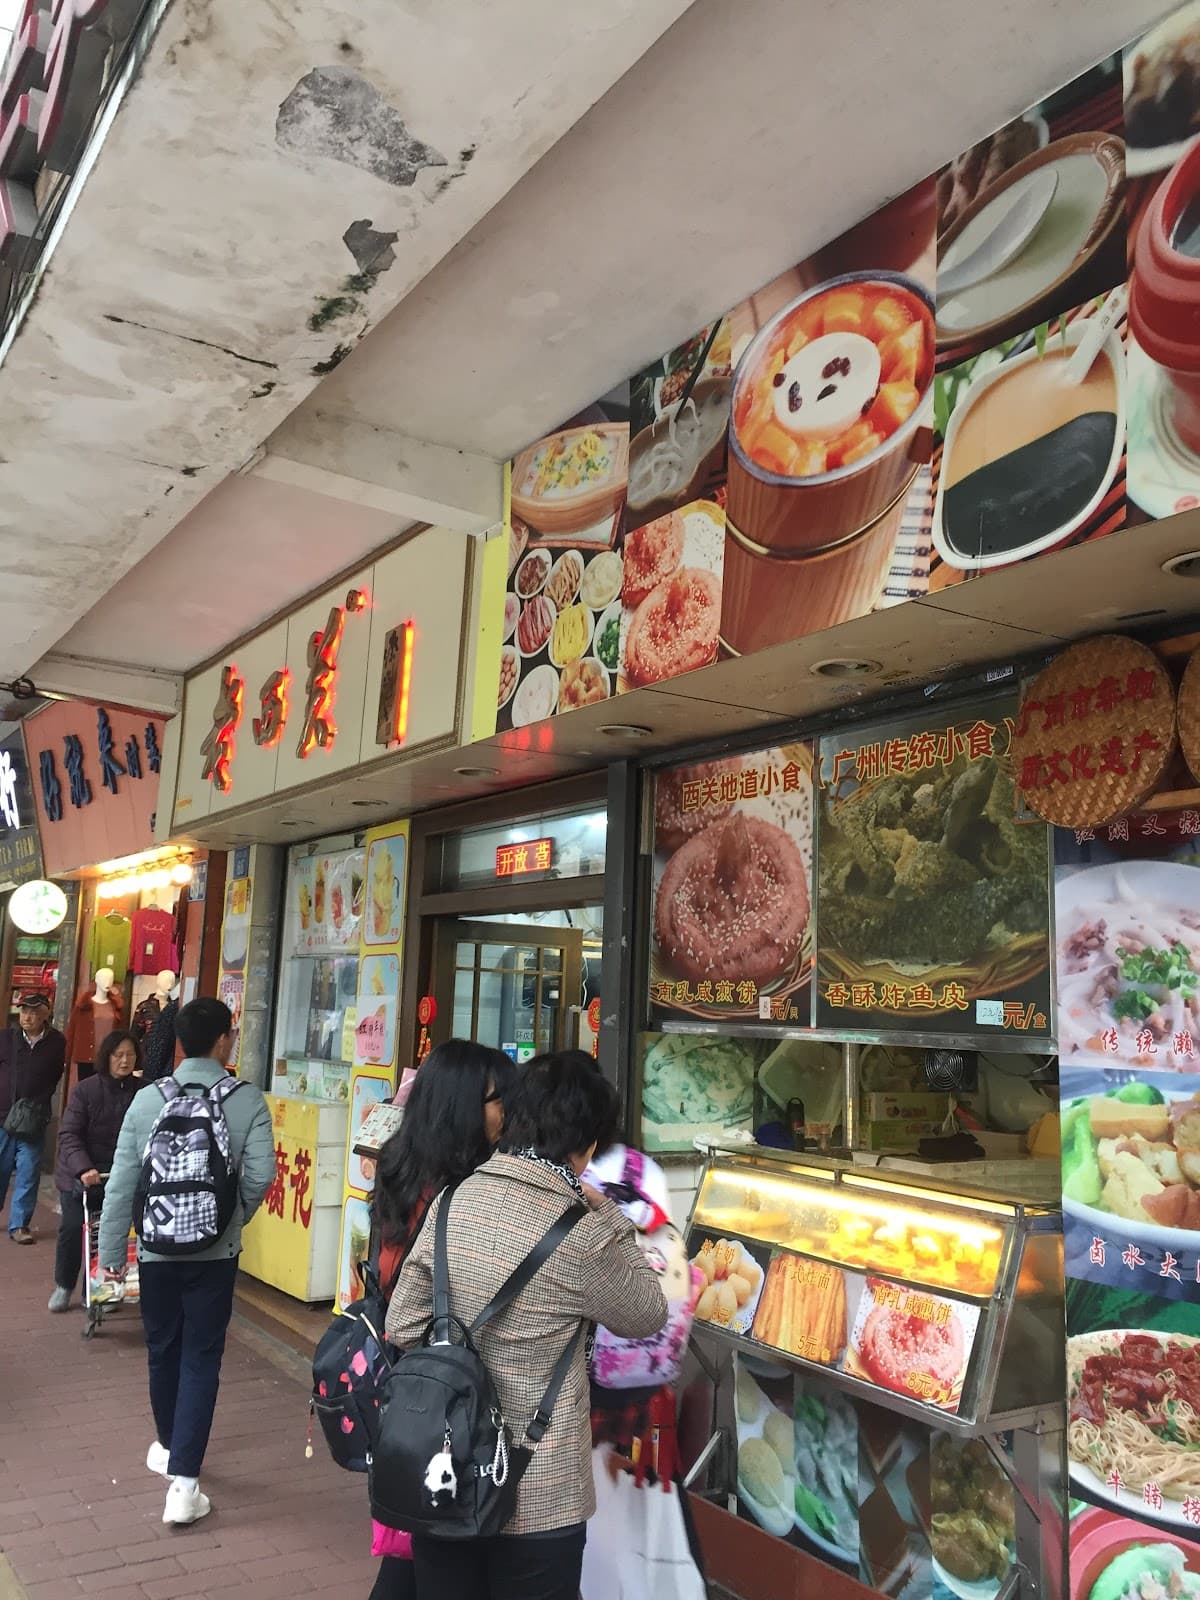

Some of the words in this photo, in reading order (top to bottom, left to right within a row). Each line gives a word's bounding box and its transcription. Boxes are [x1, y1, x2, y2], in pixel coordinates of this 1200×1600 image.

[682, 761, 801, 812] 西关地道小食
[656, 980, 757, 1004] 南乳咸煎饼
[826, 982, 969, 1009] 香酥炸鱼皮
[1101, 1027, 1195, 1057] 传统濑
[1089, 1235, 1200, 1285] 卤水大
[872, 1285, 952, 1325] 南乳咸煎饼
